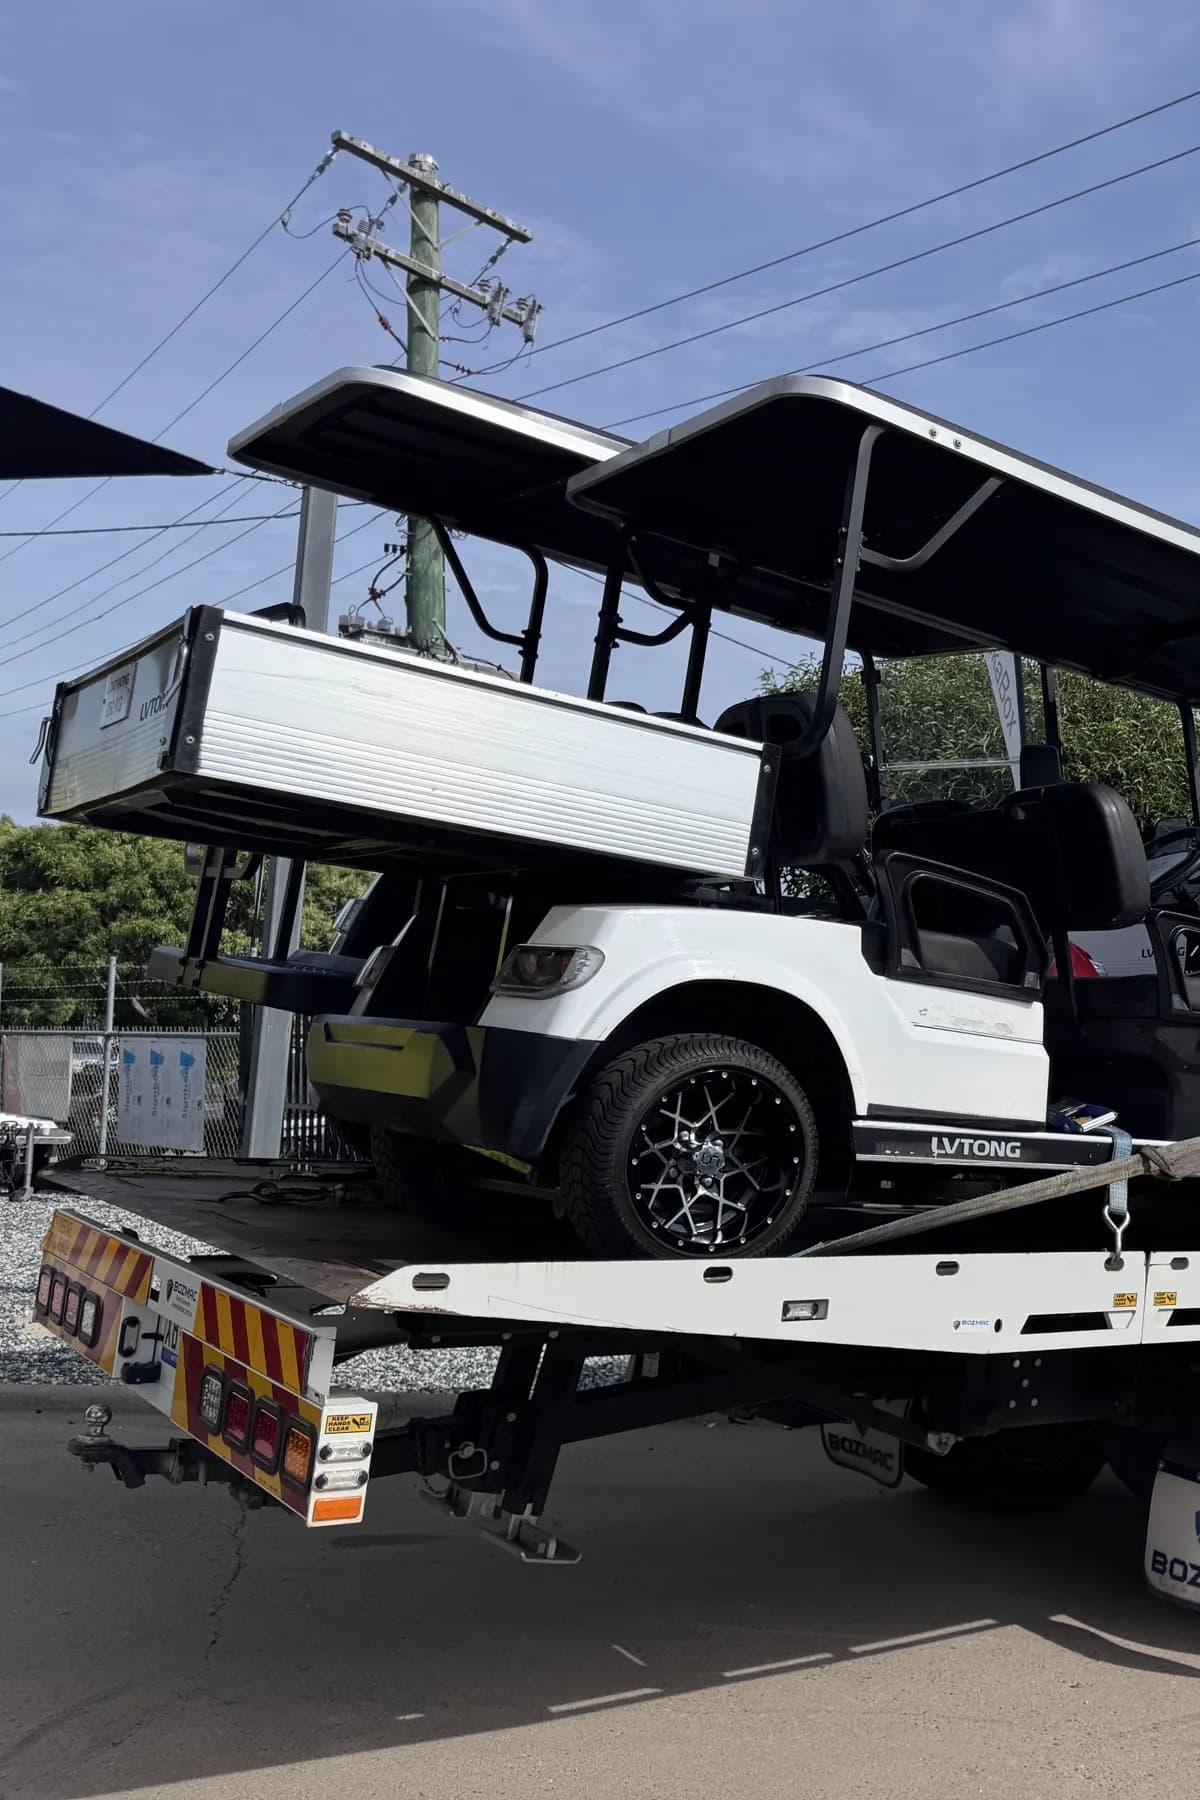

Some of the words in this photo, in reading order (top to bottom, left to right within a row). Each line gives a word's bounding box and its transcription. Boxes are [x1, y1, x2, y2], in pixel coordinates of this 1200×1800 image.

[931, 1136, 1022, 1158] LVTONG
[173, 1281, 198, 1302] BOZMAC
[828, 1432, 894, 1473] BOZMAC
